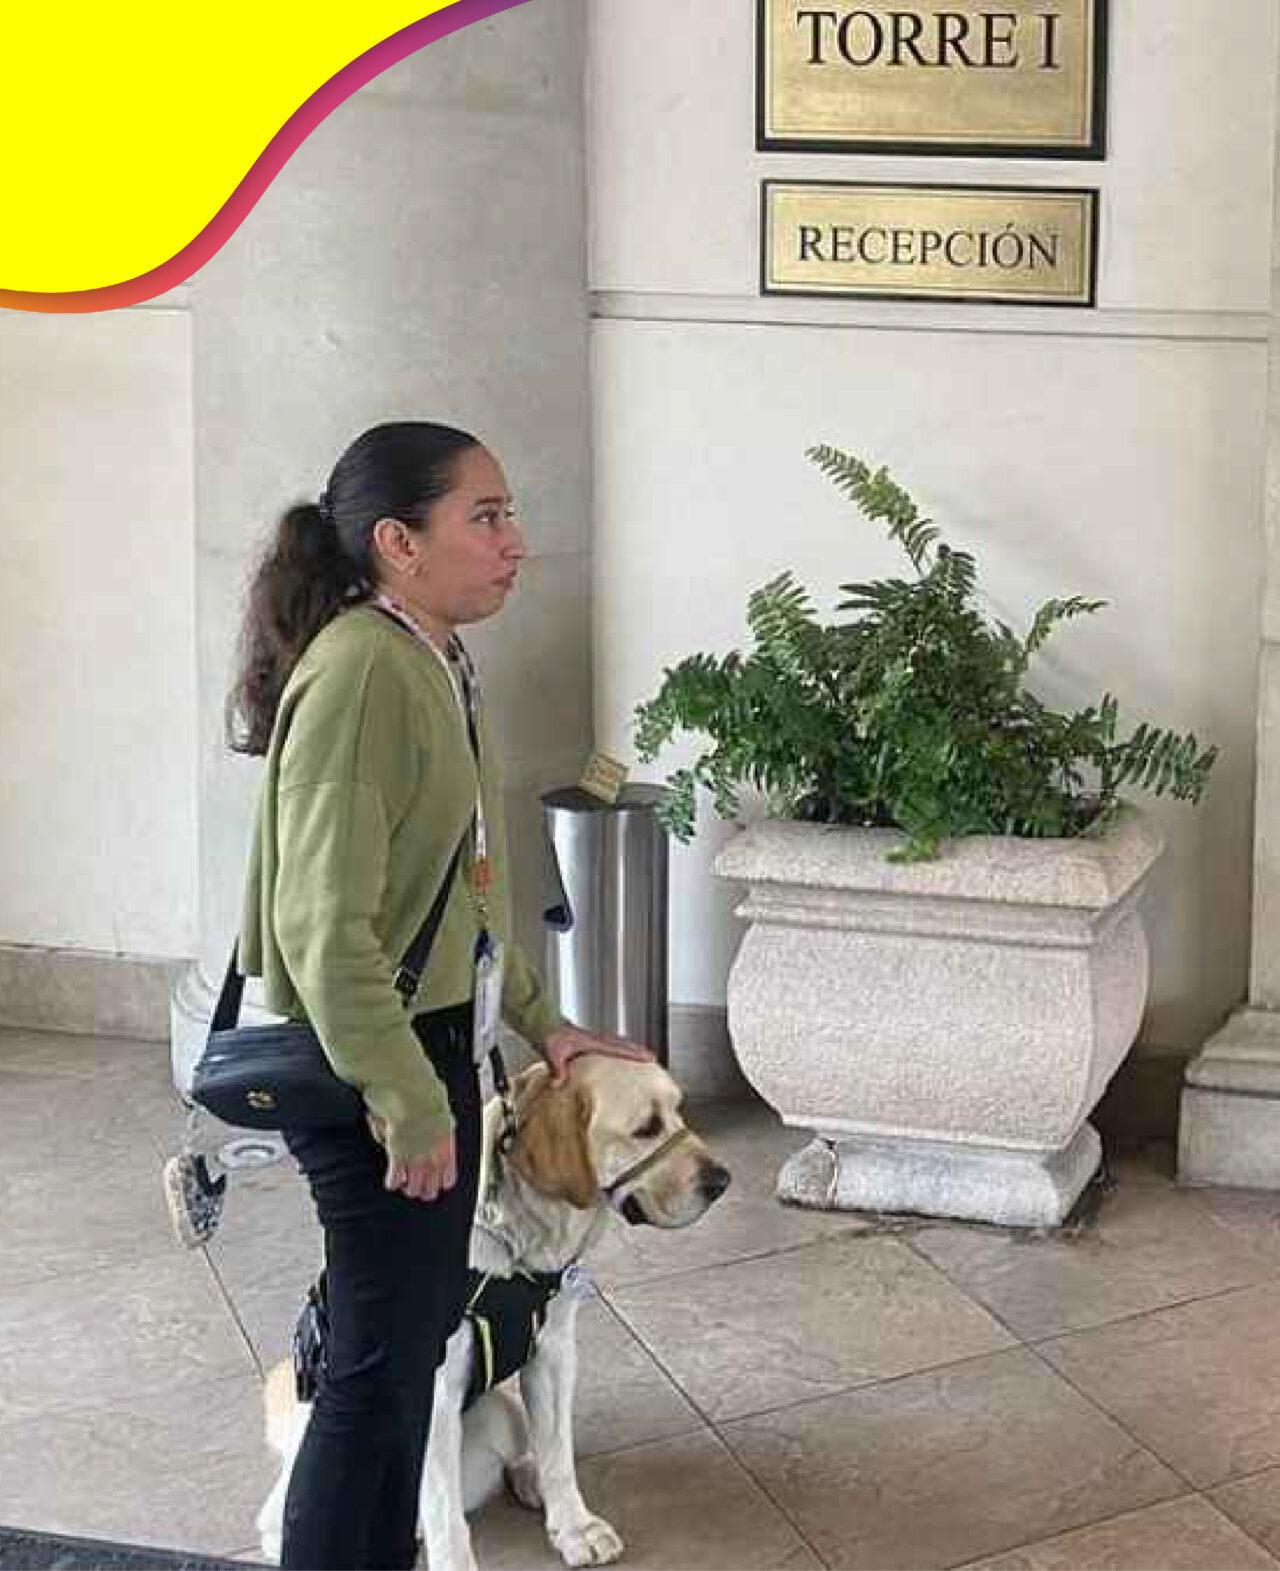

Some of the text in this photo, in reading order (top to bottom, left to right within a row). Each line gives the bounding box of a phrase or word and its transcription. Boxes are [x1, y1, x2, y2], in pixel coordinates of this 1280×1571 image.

[796, 11, 1061, 69] TORRE I
[797, 223, 1060, 269] RECEPCIÓN
